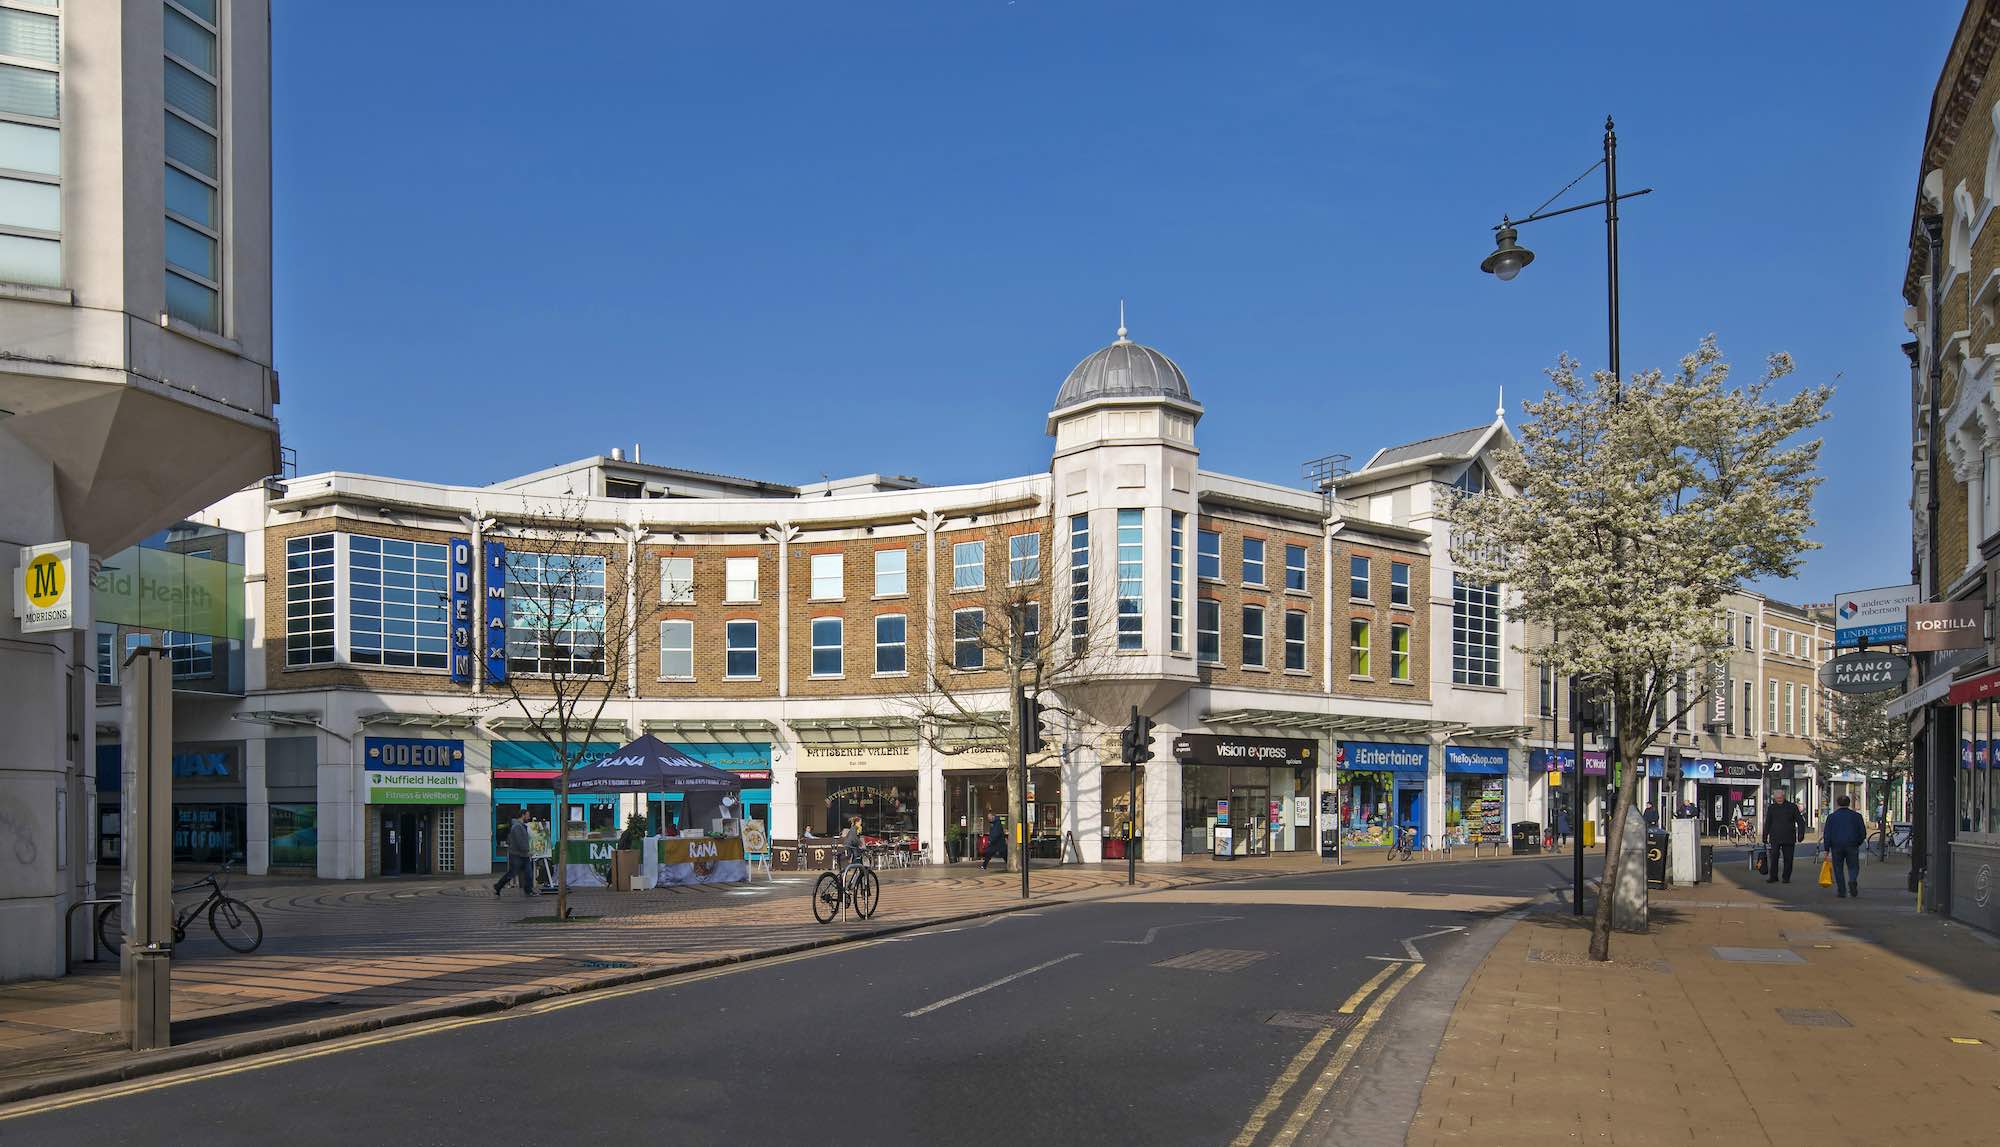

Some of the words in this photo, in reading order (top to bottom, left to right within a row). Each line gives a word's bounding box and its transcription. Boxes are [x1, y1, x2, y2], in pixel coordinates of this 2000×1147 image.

[33, 561, 58, 598] M
[141, 577, 212, 608] Health
[455, 544, 469, 676] ODEON
[488, 556, 505, 659] IMAX
[1861, 599, 1891, 608] andrew
[25, 609, 67, 623] MORRISONS
[1861, 607, 1900, 616] robertson
[1843, 628, 1878, 639] UNDER
[1879, 624, 1906, 635] OFFE
[1915, 618, 1976, 631] TORTILLA
[1835, 661, 1893, 674] FRANCO
[1836, 671, 1892, 684] MANCA
[1711, 696, 1726, 721] hmv
[382, 744, 450, 766] ODEON
[807, 747, 864, 757] PATISSERIE
[867, 746, 910, 756] VALERIE
[1216, 742, 1246, 757] vision
[1247, 745, 1287, 760] express
[1361, 749, 1424, 766] Entertainer
[1450, 752, 1504, 767] TheToyShop.com
[1586, 758, 1593, 769] PC
[1728, 766, 1746, 776] CURZON
[1769, 762, 1783, 772] JD
[384, 774, 424, 785] Nuffield
[427, 775, 458, 785] Health
[384, 791, 414, 799] Fitness
[422, 791, 459, 801] Wellbeing
[589, 843, 618, 860] RAN
